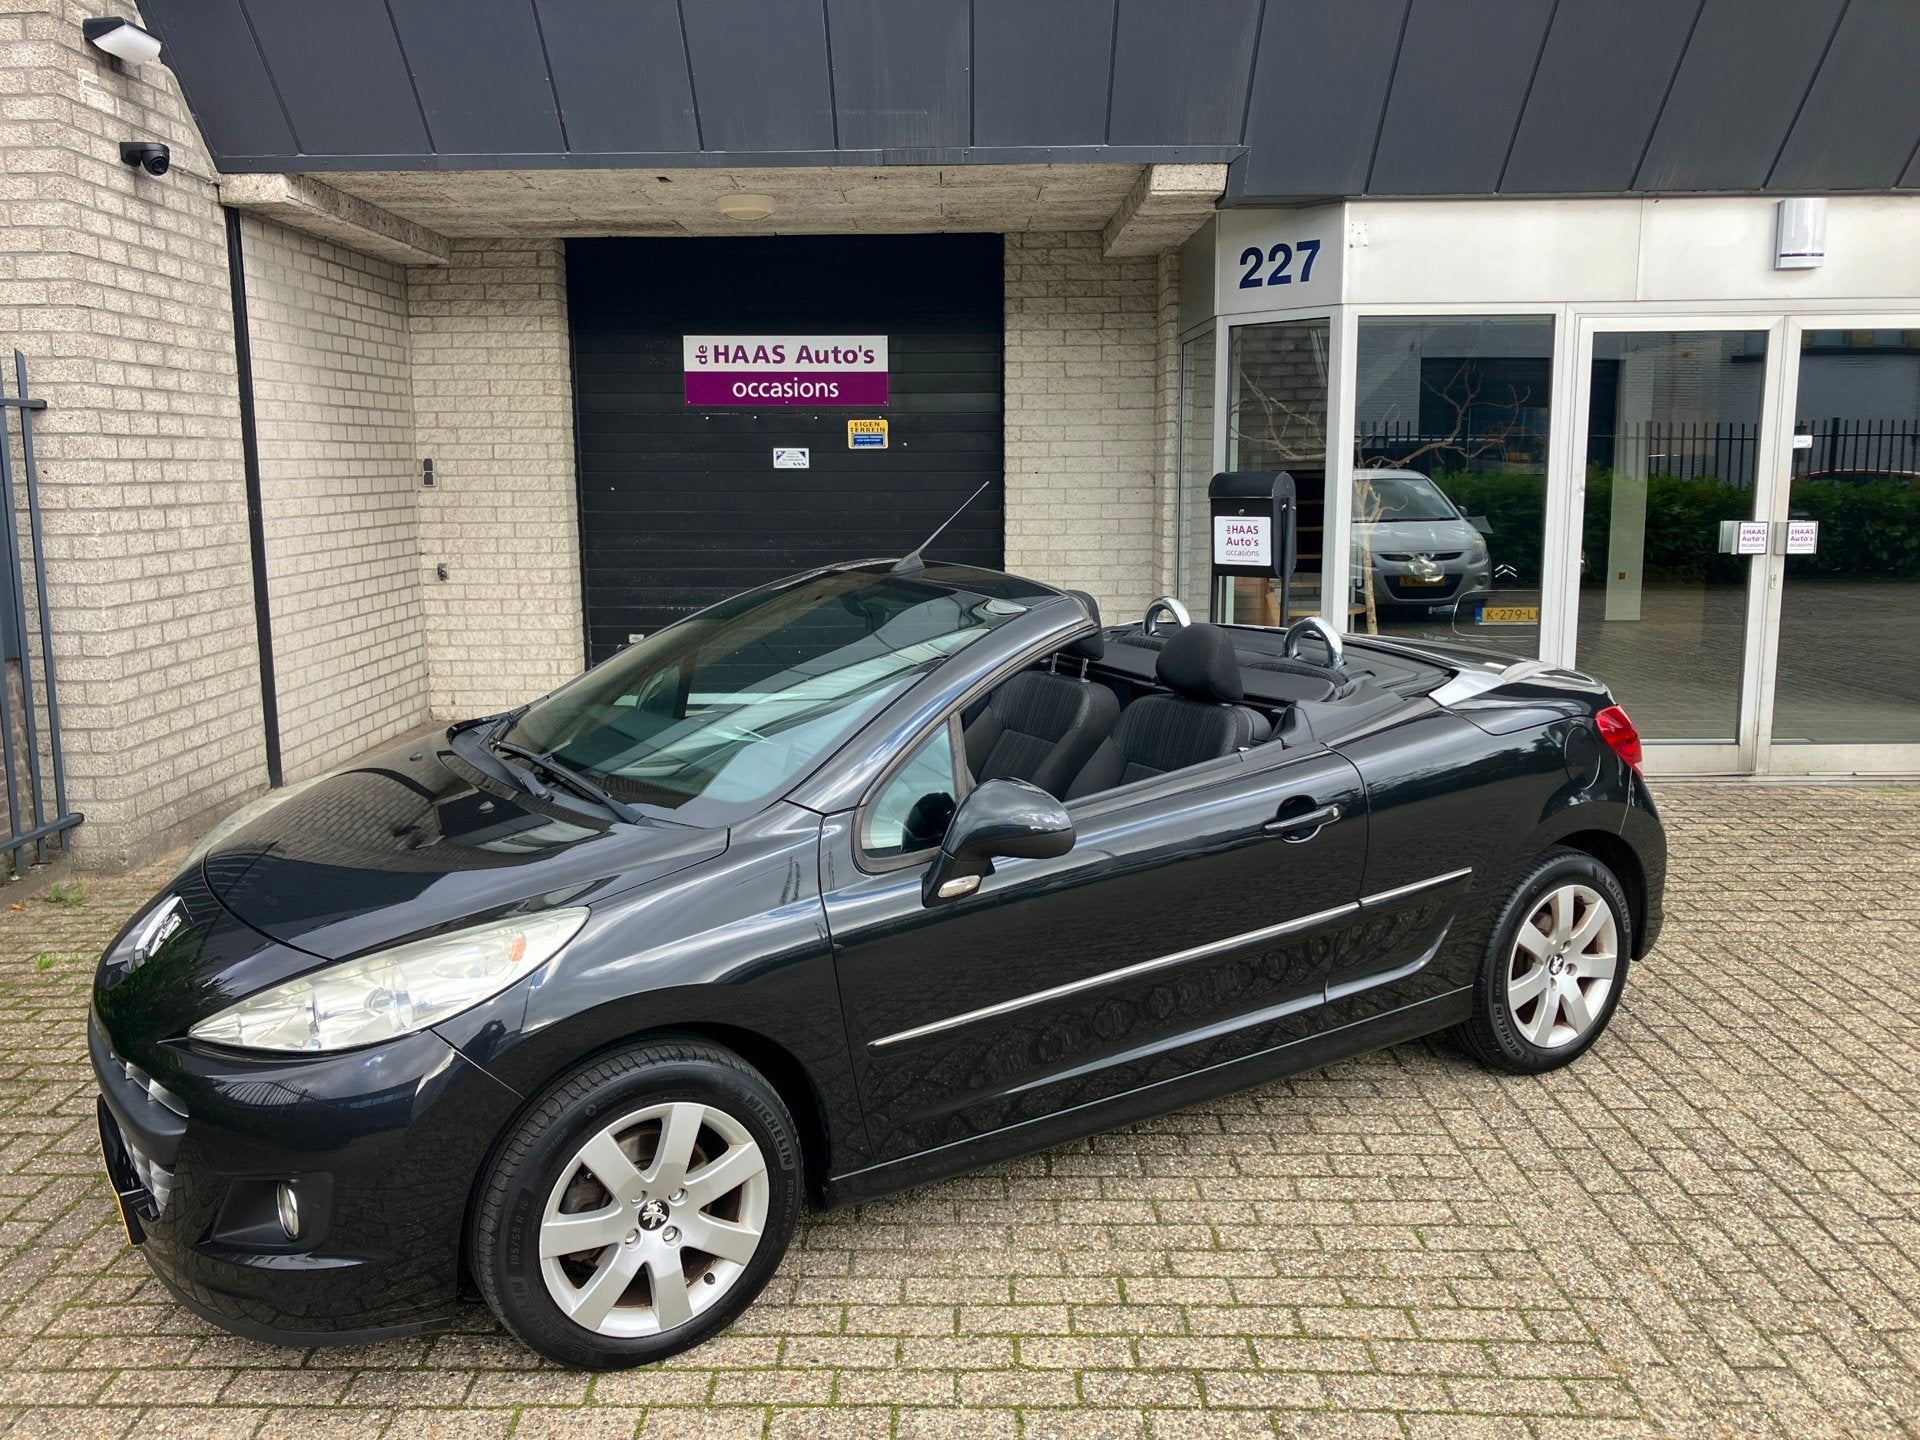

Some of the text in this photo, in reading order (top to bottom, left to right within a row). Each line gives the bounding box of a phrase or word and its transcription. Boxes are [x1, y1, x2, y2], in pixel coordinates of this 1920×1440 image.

[1239, 239, 1321, 290] 227
[695, 344, 875, 365] de HAAS Auto's
[732, 376, 839, 398] occasions
[1231, 525, 1259, 535] HAAS
[1226, 537, 1259, 547] Auto's
[1226, 548, 1260, 557] occasions
[1608, 881, 1630, 930] MICHELIN
[1495, 1006, 1522, 1057] MICHELIN
[745, 1094, 793, 1166] MICHELIN
